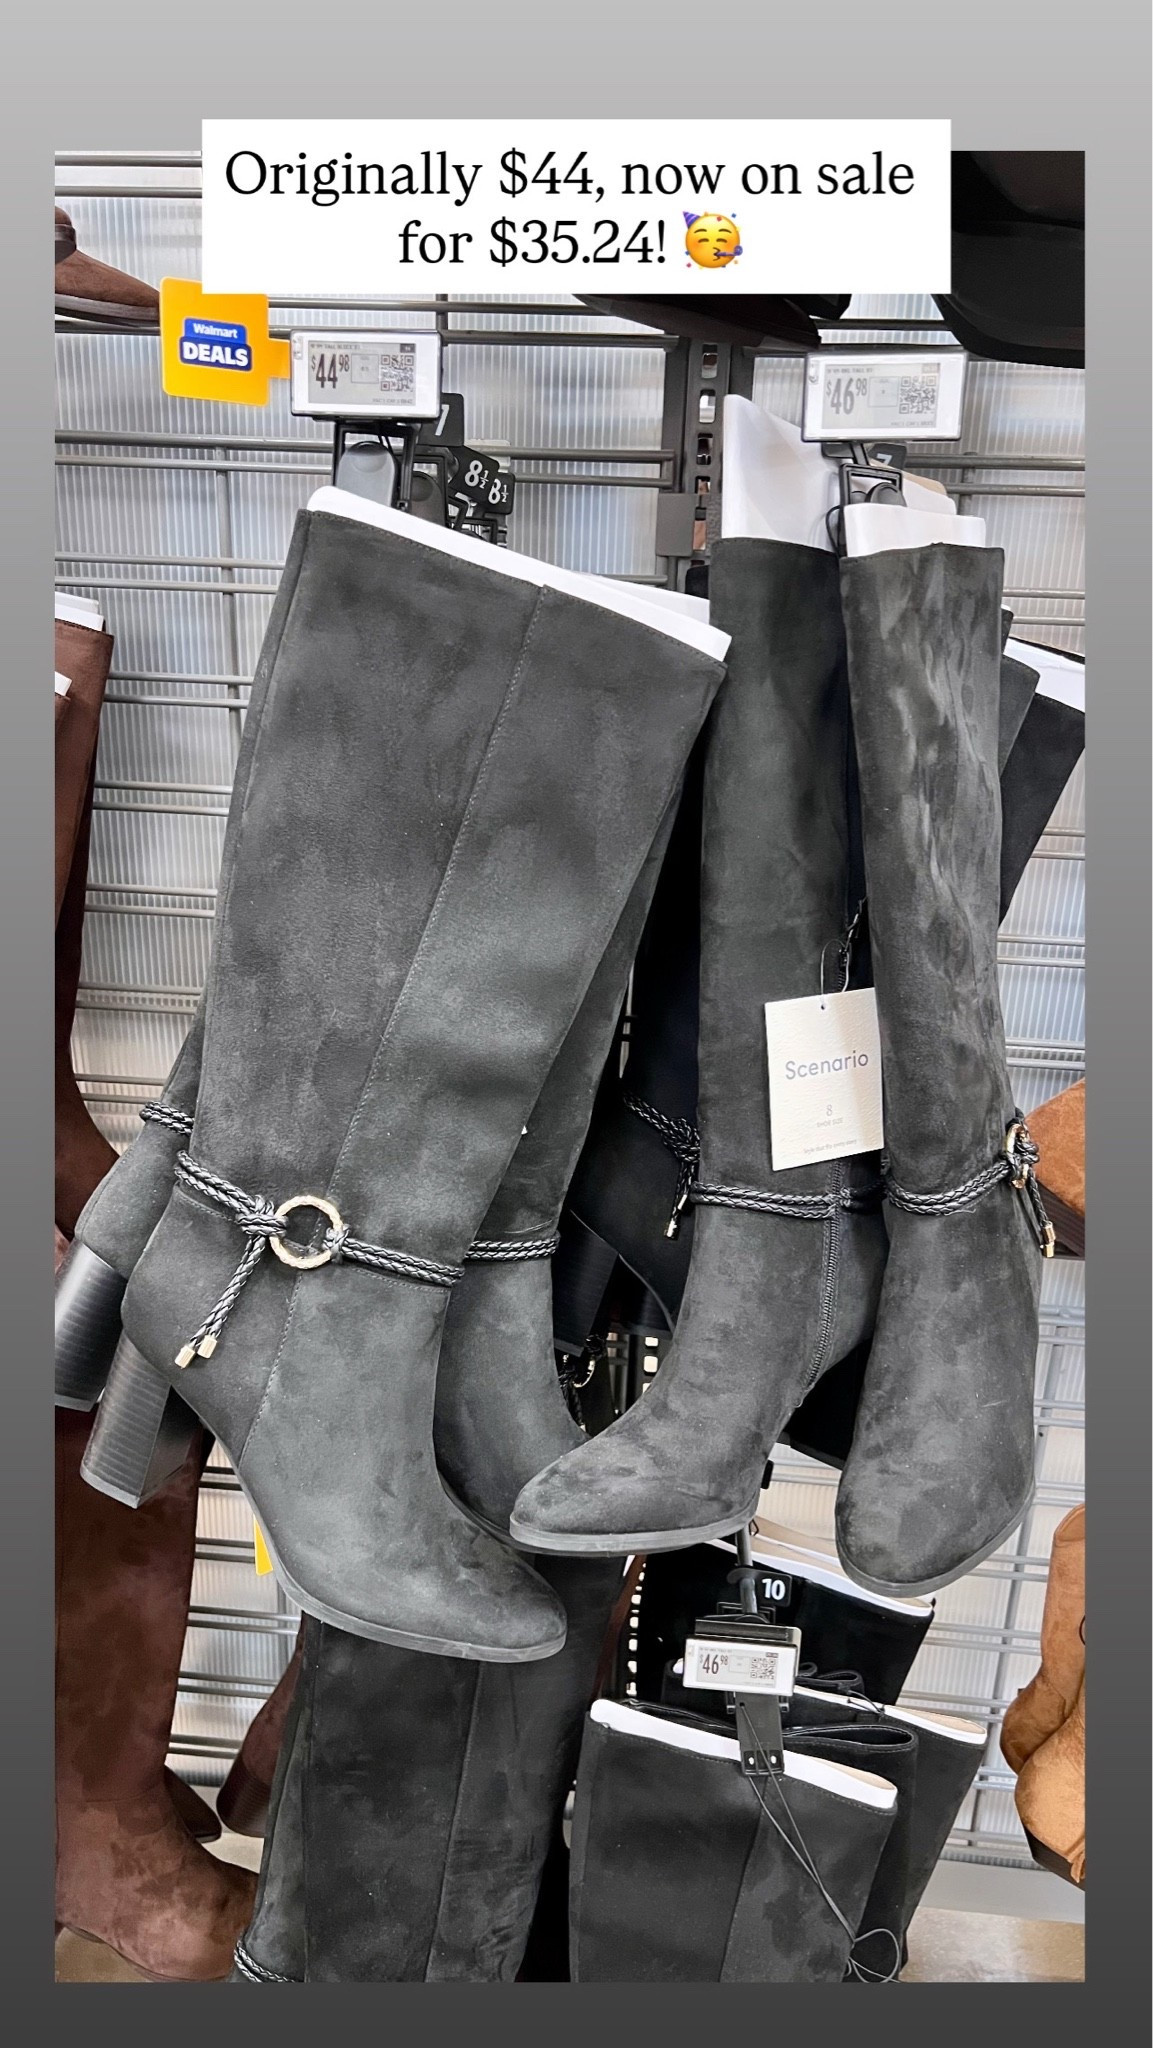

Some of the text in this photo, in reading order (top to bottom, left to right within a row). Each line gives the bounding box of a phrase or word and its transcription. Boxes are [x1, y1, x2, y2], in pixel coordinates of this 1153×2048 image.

[193, 323, 238, 339] Walmart
[182, 341, 249, 367] DEALS
[785, 1050, 869, 1080] Scenario
[826, 1104, 833, 1117] 8
[762, 1578, 786, 1600] 10
